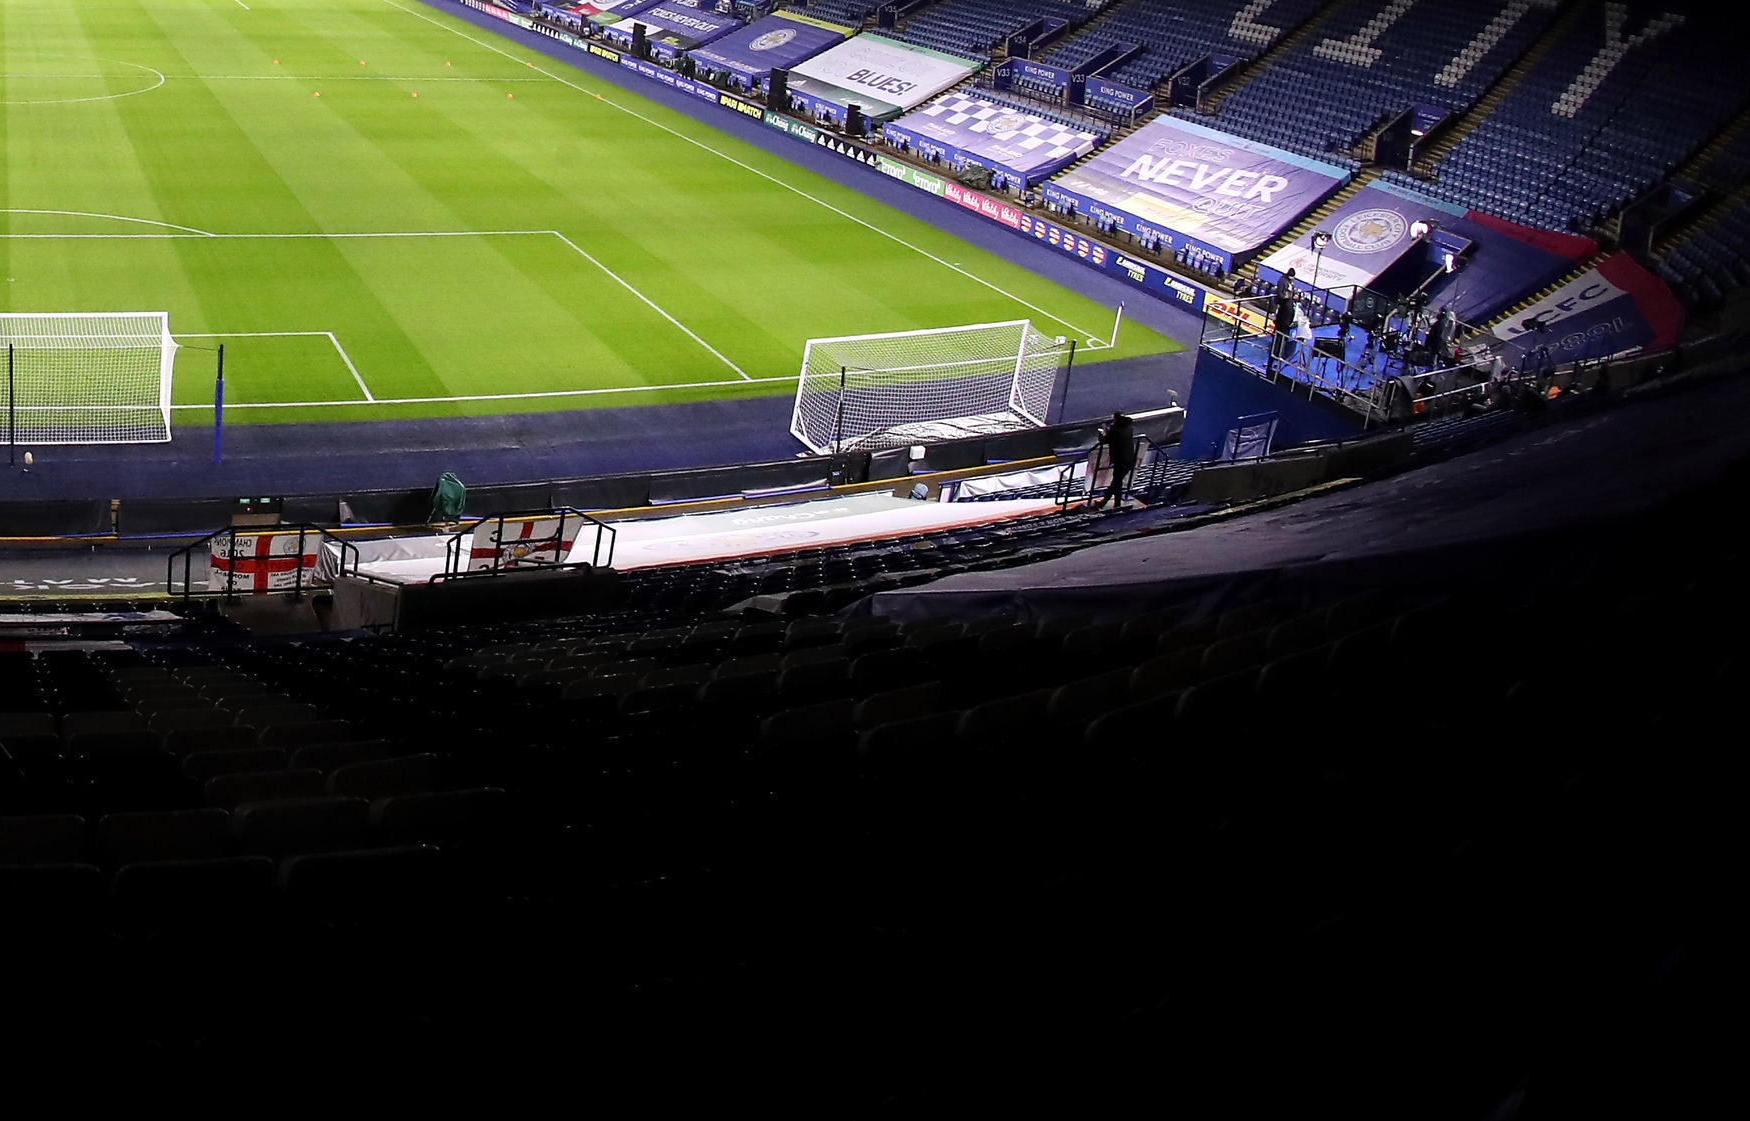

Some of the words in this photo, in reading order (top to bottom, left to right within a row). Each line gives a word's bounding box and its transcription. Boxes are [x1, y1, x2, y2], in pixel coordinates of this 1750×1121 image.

[648, 7, 671, 21] FOXES
[670, 12, 696, 29] NEVER
[694, 19, 720, 32] QUIT
[997, 68, 1010, 78] V33
[1025, 65, 1037, 75] KING
[1037, 68, 1055, 79] POWER
[1072, 74, 1086, 83] V33
[846, 68, 918, 96] BLUES!
[1100, 86, 1114, 96] KING
[1114, 90, 1134, 101] POWER
[772, 115, 789, 131] Chang
[798, 121, 816, 139] Chang
[1150, 138, 1235, 162] FOXES
[1120, 153, 1289, 203] NEVER
[1046, 189, 1060, 200] KING
[1060, 194, 1079, 208] POWER
[1089, 205, 1105, 217] KING
[1104, 211, 1125, 225] POWER
[1191, 197, 1265, 221] QUIT
[1136, 223, 1151, 235] KING
[1151, 230, 1173, 244] POWER
[1185, 242, 1202, 256] KING
[1201, 249, 1224, 265] POWER
[1176, 290, 1195, 305] TYRES
